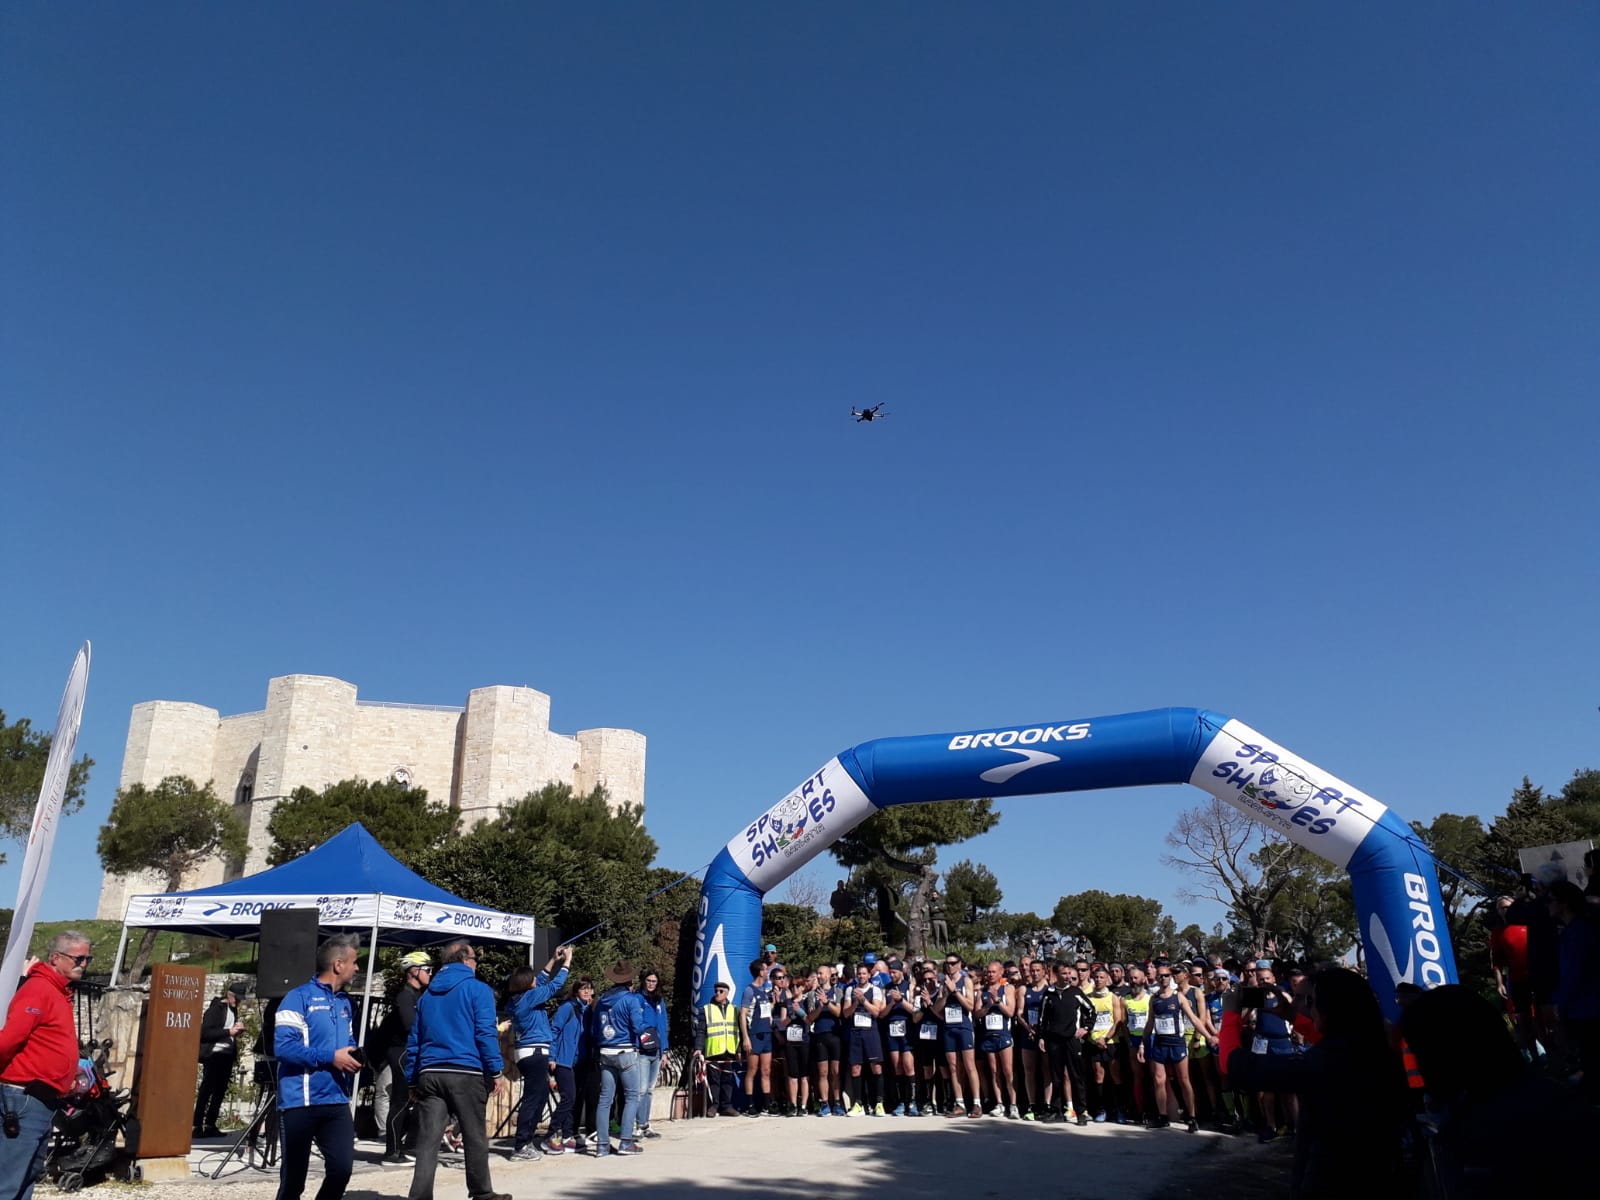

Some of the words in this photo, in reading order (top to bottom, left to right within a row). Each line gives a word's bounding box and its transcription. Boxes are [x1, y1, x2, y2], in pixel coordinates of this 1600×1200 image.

[948, 723, 1090, 750] BROOKS
[454, 912, 492, 930] BROOKS
[1403, 872, 1446, 989] BROO
[165, 974, 199, 987] TAVERNA
[166, 1011, 191, 1028] BAR
